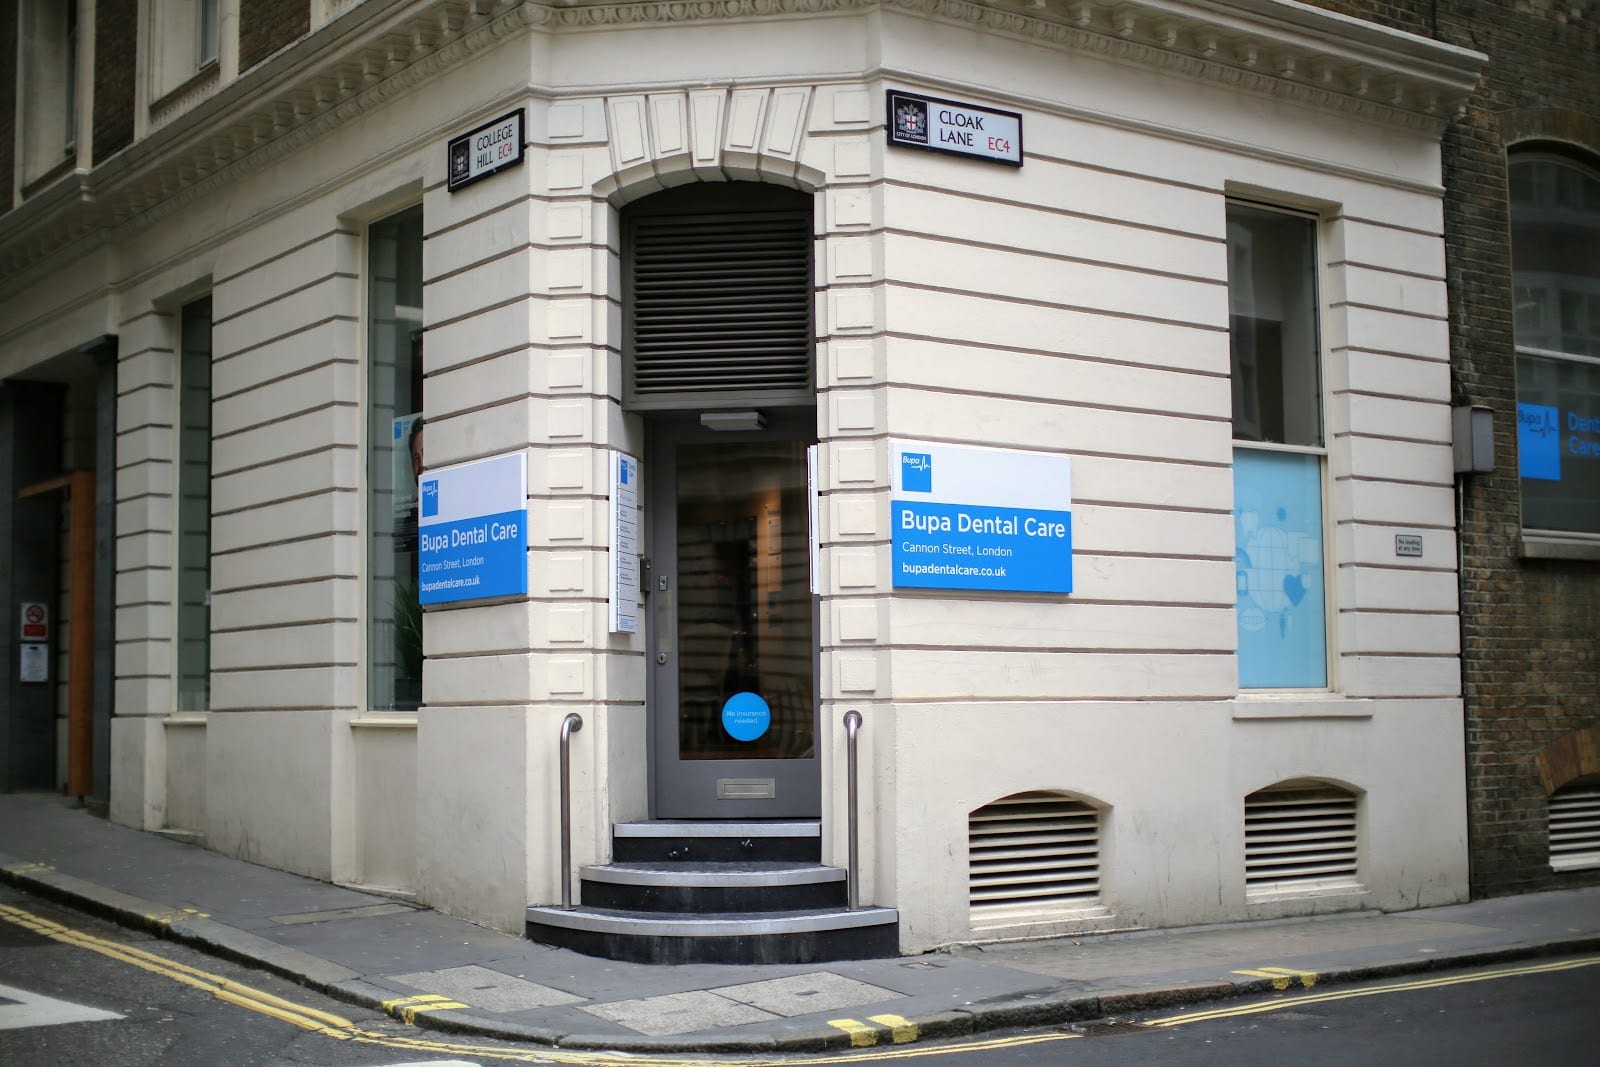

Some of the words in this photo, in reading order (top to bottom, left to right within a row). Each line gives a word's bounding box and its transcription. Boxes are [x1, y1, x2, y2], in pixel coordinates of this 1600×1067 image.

[939, 110, 984, 130] CLOAK
[477, 124, 513, 151] COLLEGE
[939, 128, 974, 146] LANE
[988, 137, 1011, 153] EC4
[477, 151, 493, 169] HILL
[498, 142, 513, 160] EC4
[1568, 434, 1600, 456] Care
[903, 456, 919, 465] Bupa
[902, 510, 951, 534] Bupa
[957, 513, 1018, 535] Dental
[1024, 517, 1066, 538] Care
[421, 534, 449, 554] Bupa
[451, 523, 488, 548] Dental
[491, 522, 518, 541] Care
[902, 541, 939, 553] Cannon
[942, 543, 975, 556] Street,
[976, 545, 1013, 557] London
[421, 561, 442, 573] Cannon
[443, 558, 462, 570] Street,
[462, 556, 484, 567] London
[902, 562, 1006, 577] bupadentalcare.co.uk
[421, 576, 480, 592] bupadentalcare.co.uk
